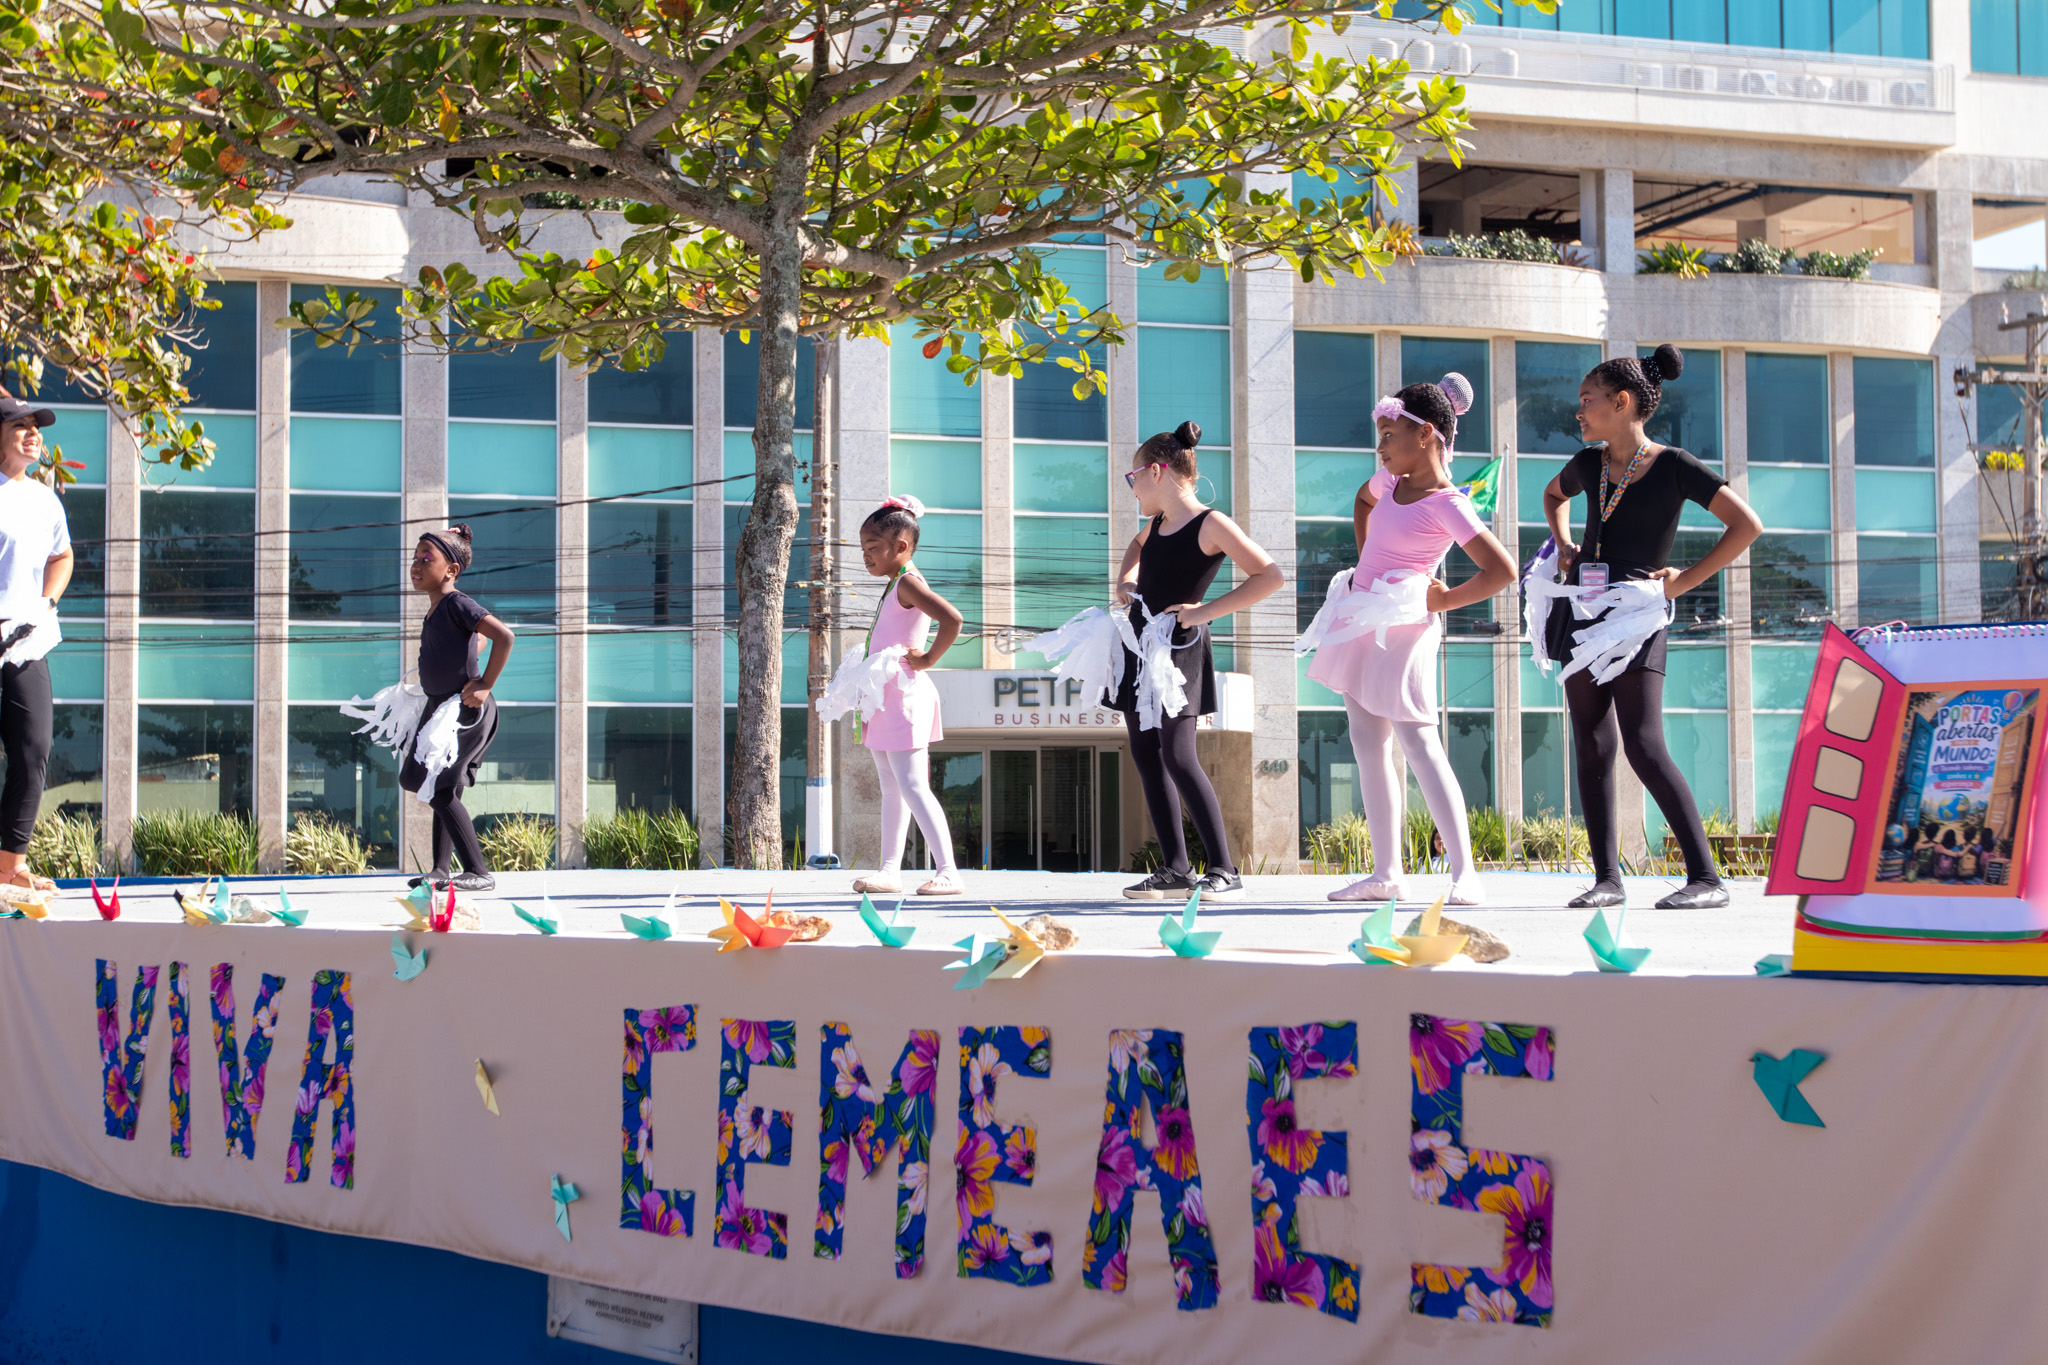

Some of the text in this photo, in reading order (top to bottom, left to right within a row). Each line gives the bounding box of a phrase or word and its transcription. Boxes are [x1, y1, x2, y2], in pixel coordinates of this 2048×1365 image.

[994, 713, 1121, 726] BUSINESS
[1939, 705, 2000, 725] PORTAS
[1936, 719, 1999, 742] abertas
[1933, 746, 1996, 763] MUNDO:
[1260, 759, 1289, 774] 340
[96, 958, 1556, 1328] VIVA CEMEAES
